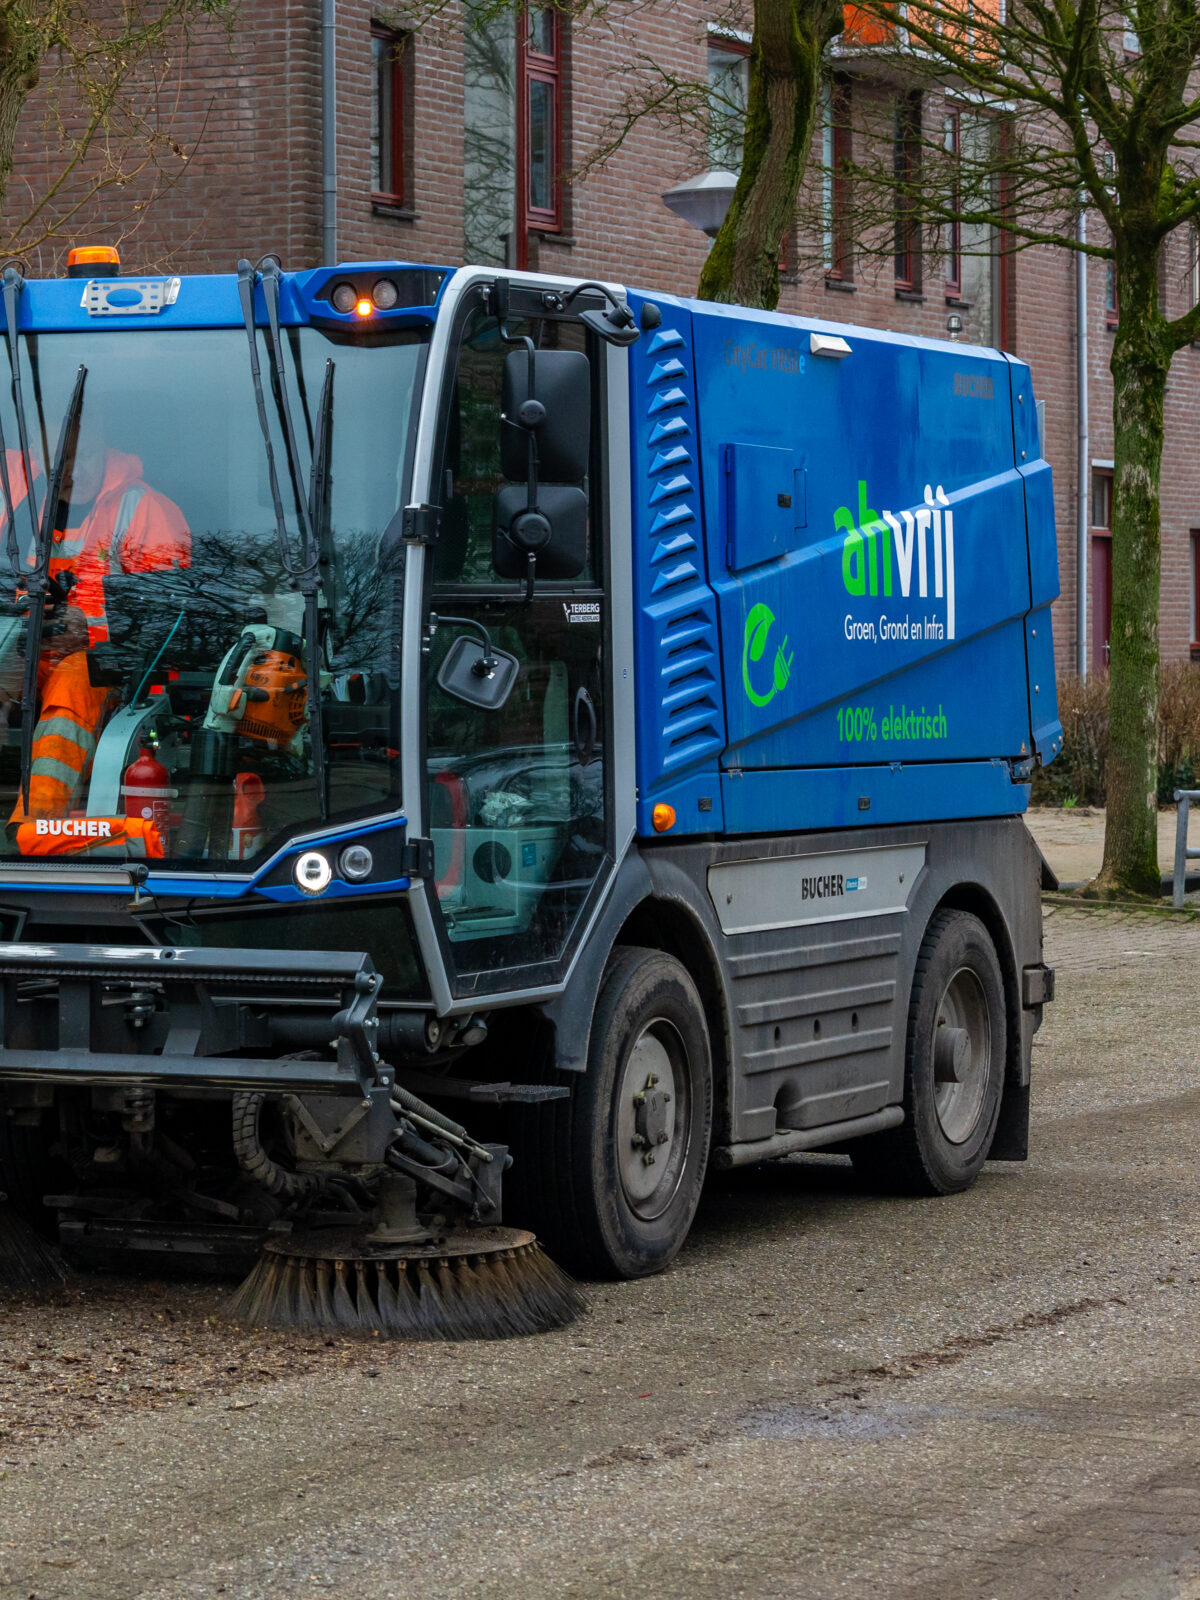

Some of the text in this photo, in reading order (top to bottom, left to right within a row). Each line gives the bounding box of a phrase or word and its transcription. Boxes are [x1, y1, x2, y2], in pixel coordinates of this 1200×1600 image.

[724, 339, 806, 375] CityCat VR50e
[953, 373, 995, 400] BUCHER
[833, 480, 955, 640] ahvrij
[570, 603, 600, 613] TERBERG
[844, 614, 944, 644] Groen, Grond en Infra
[836, 704, 947, 742] 100% elektrisch
[35, 819, 112, 837] BUCHER
[801, 874, 844, 900] BUCHER
